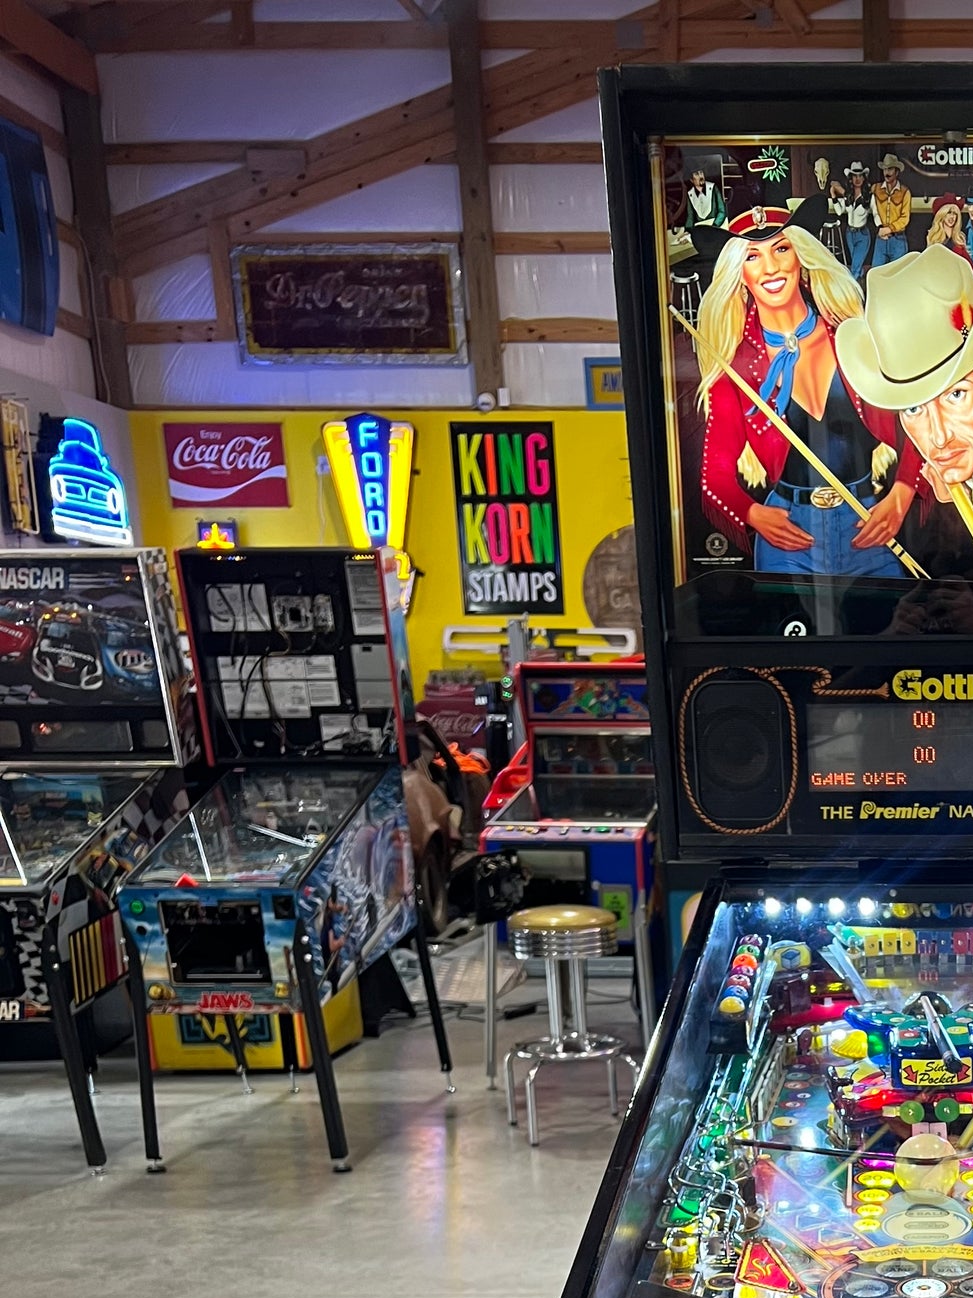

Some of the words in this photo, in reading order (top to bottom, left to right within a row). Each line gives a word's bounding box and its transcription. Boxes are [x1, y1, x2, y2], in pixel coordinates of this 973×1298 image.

[199, 429, 222, 441] Enjoy
[172, 434, 274, 471] Coca-Cola
[457, 432, 551, 496] KING
[358, 421, 387, 537] FORD
[462, 502, 555, 565] KORN
[0, 566, 65, 590] NASCAR
[467, 571, 558, 603] STAMPS
[912, 710, 937, 729] 00
[912, 746, 937, 764] 00
[810, 772, 856, 787] GAME
[862, 771, 908, 786] OVER
[820, 805, 853, 820] THE
[859, 800, 940, 820] Premier
[197, 991, 255, 1012] JAWS
[918, 1072, 956, 1085] Pocket
